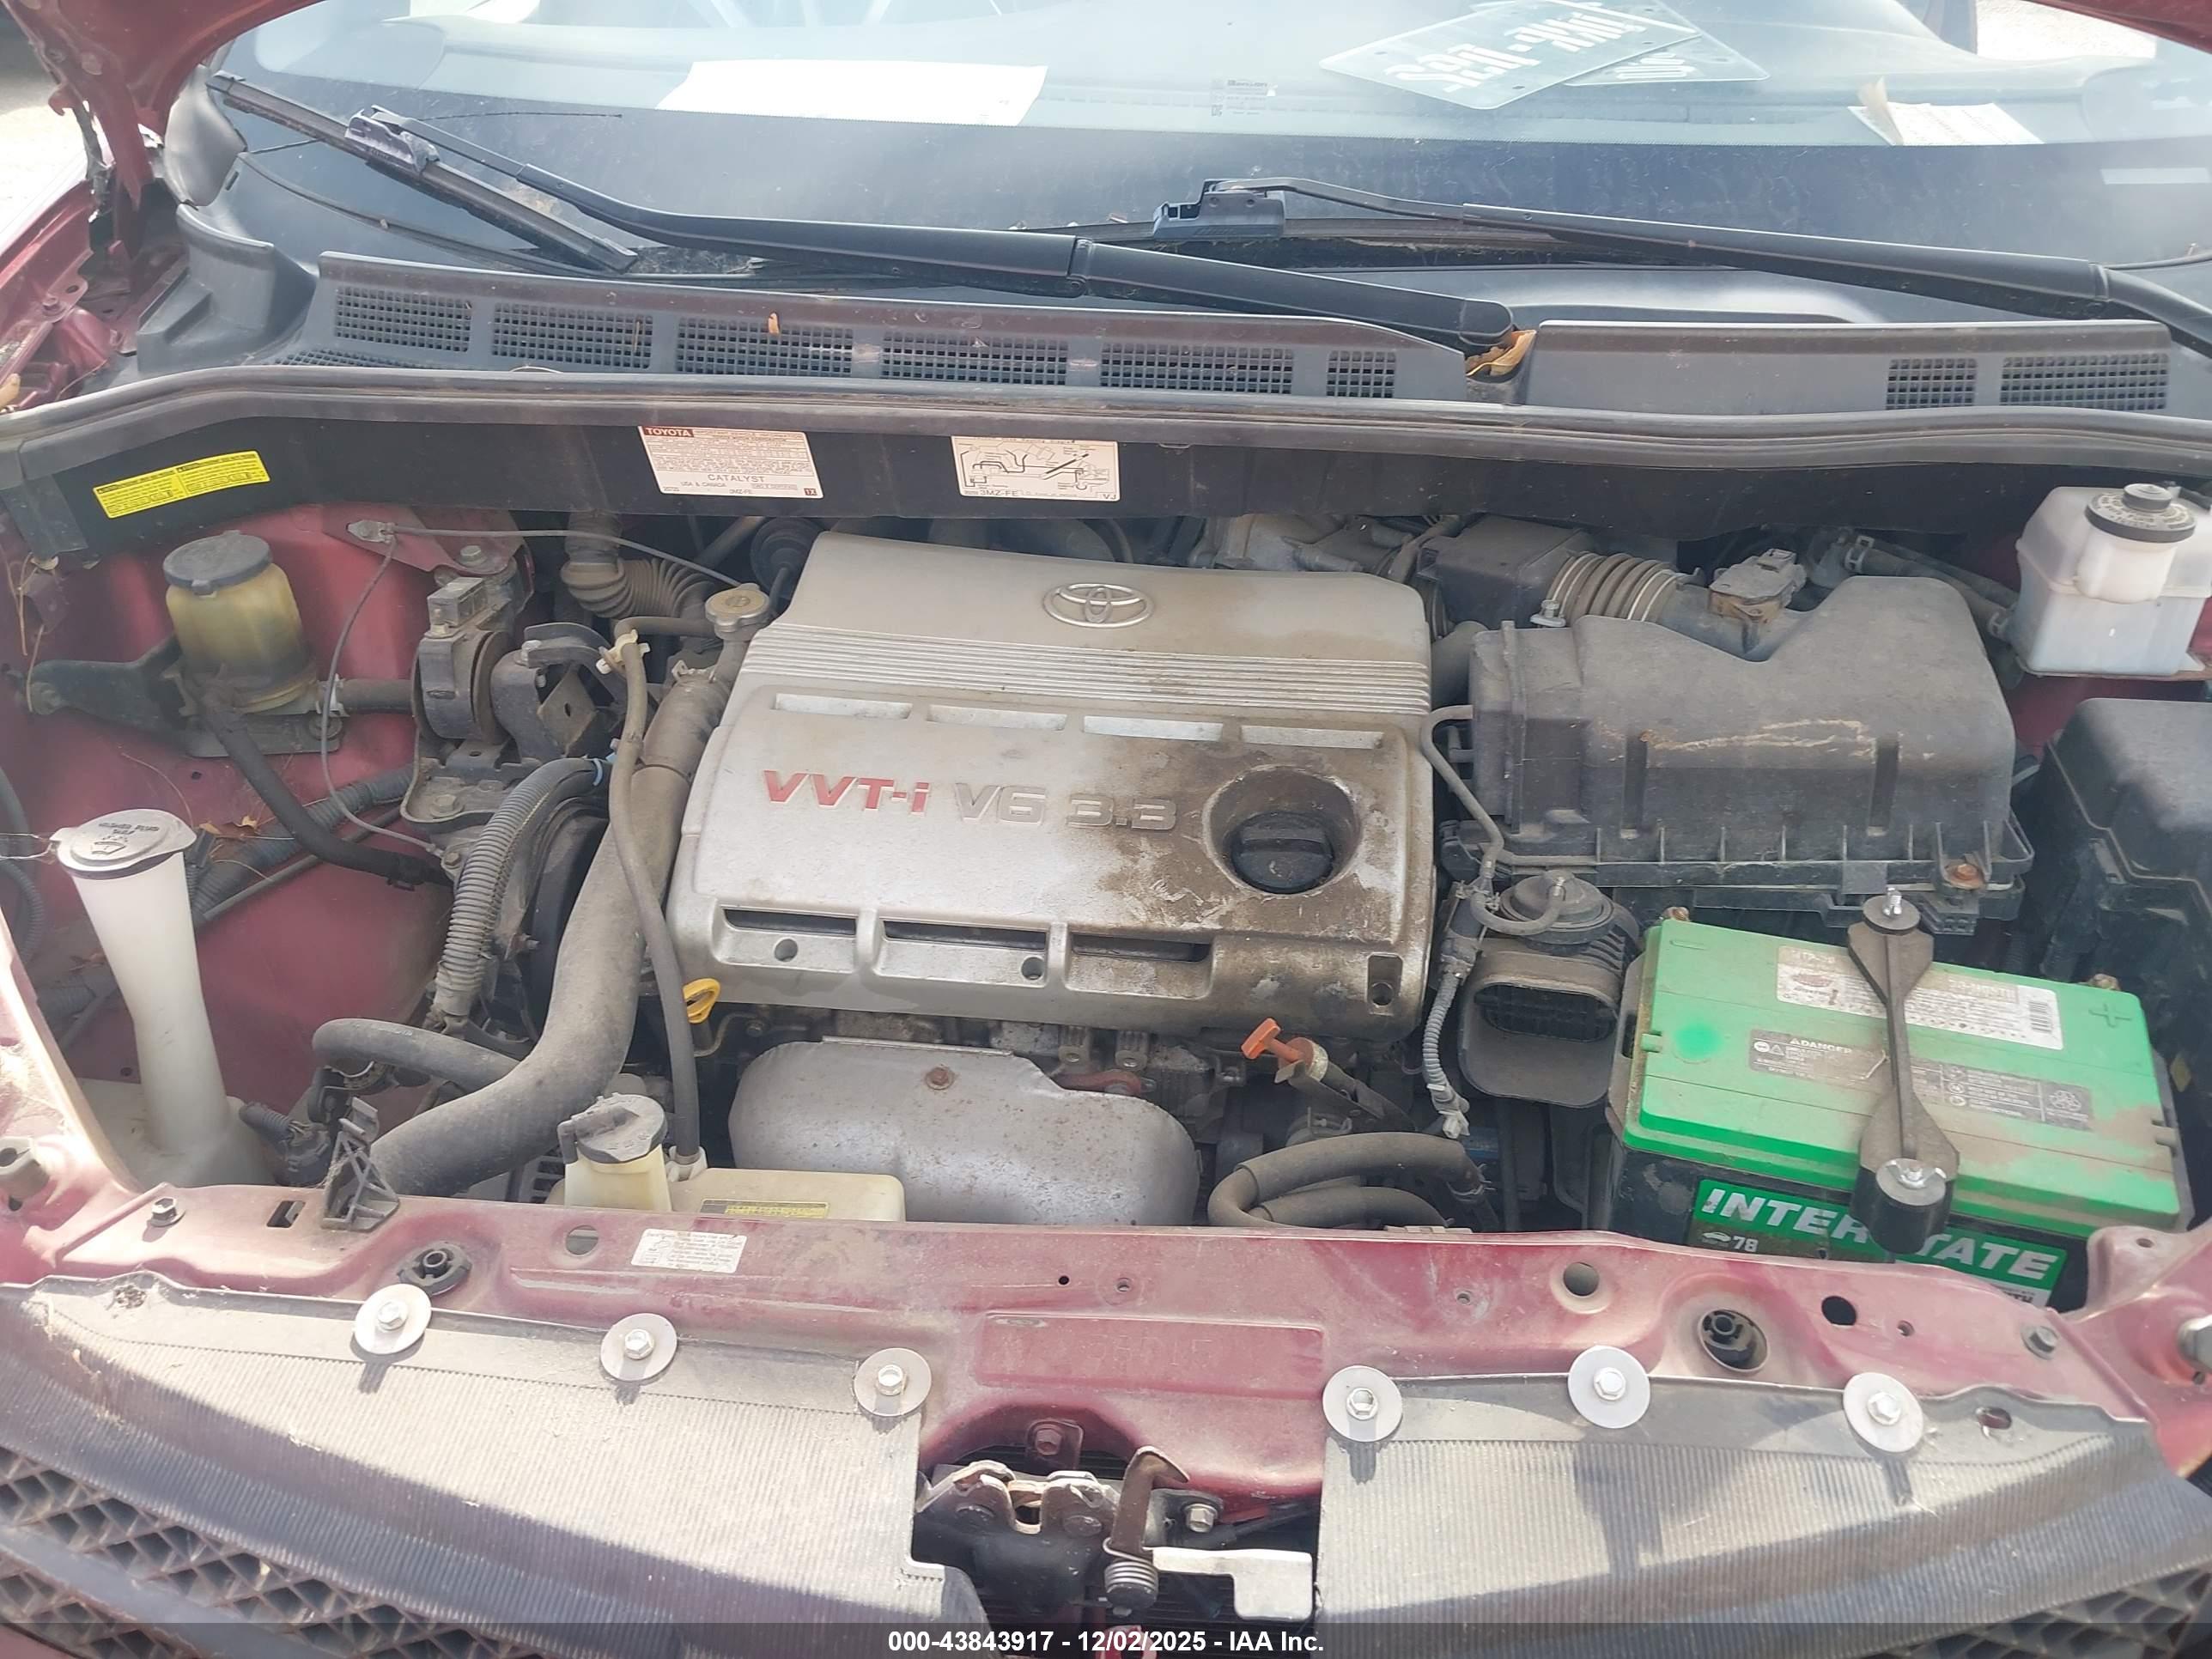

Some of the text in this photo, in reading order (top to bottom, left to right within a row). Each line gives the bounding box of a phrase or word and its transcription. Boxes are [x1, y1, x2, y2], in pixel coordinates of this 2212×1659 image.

[645, 427, 692, 437] TOYOTA
[707, 473, 765, 483] CATALYST
[763, 769, 1177, 831] VVT-i V6 3.3
[1701, 1188, 2058, 1280] INTERTATE
[1733, 1236, 1759, 1253] 78
